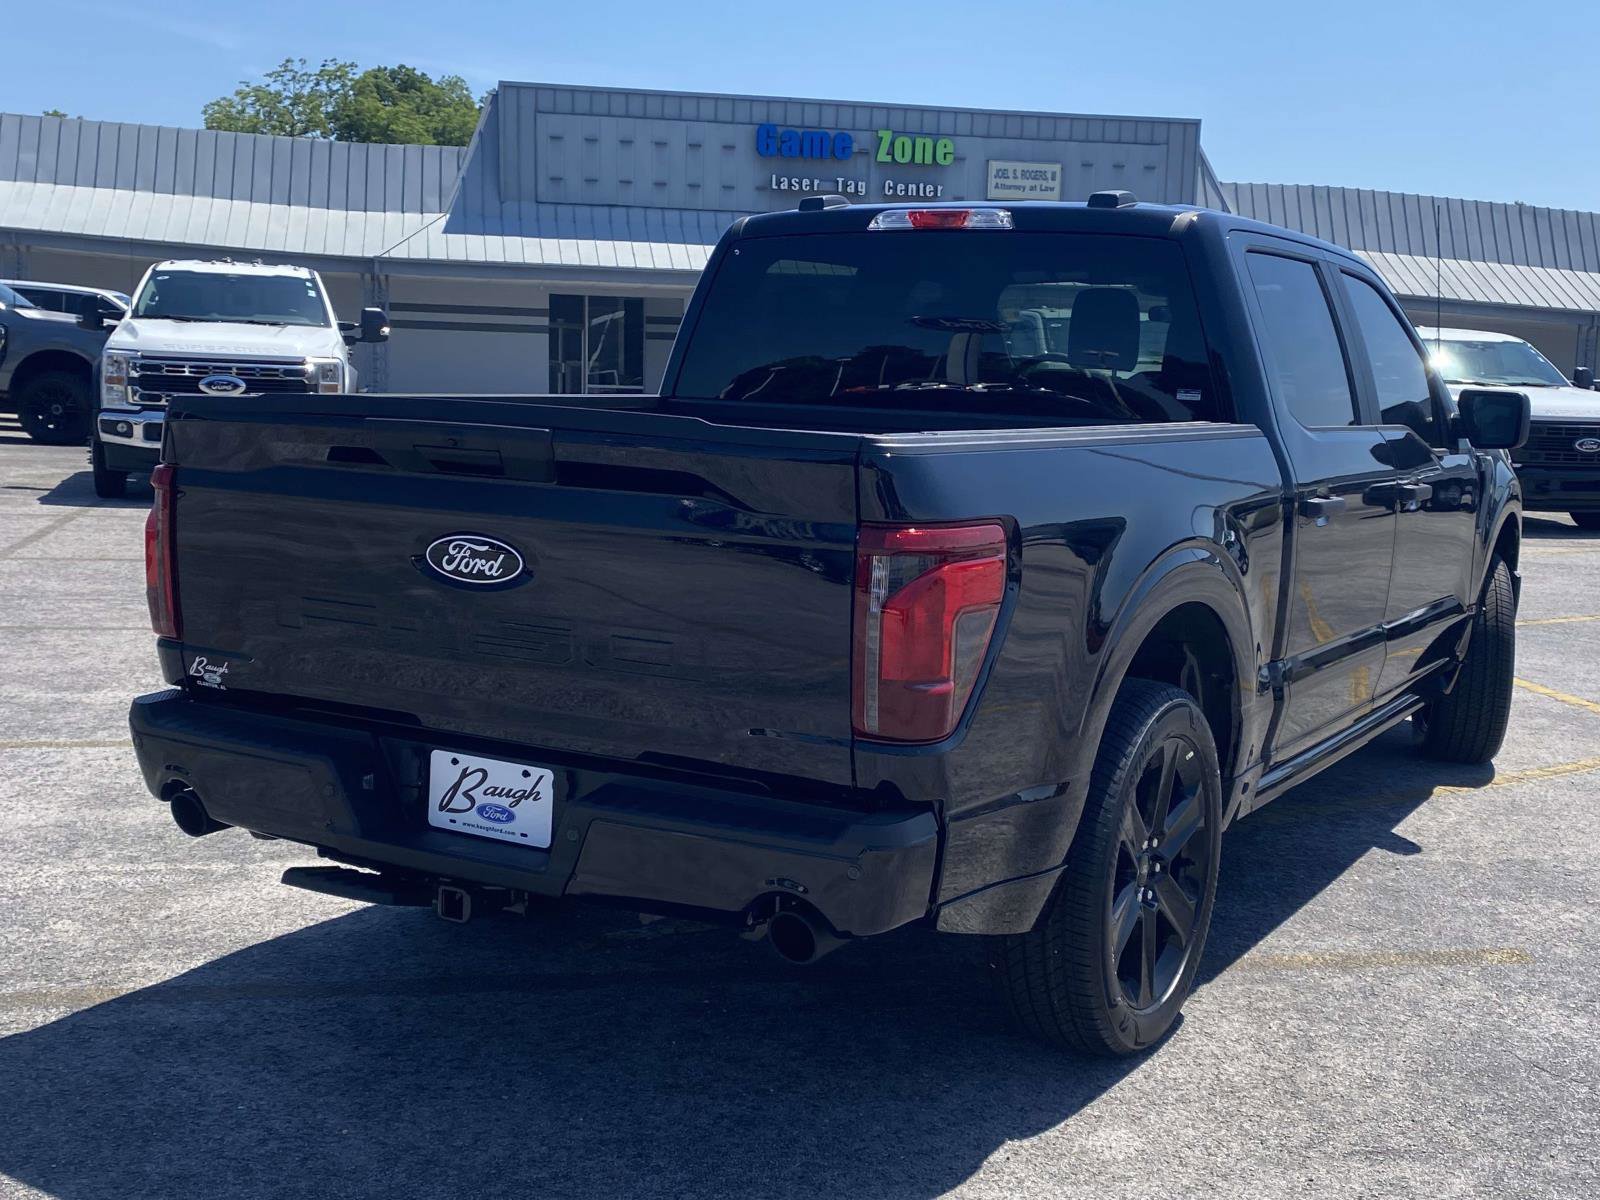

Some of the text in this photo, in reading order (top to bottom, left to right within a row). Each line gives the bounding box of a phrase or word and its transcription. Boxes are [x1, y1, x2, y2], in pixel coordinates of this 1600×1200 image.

[757, 122, 955, 166] Game Zone
[994, 168, 1010, 179] JOEL
[771, 174, 944, 197] Laser Tag Center
[994, 182, 1055, 192] Attorney at Law
[442, 541, 505, 577] Ford
[190, 656, 228, 676] Baugh
[438, 766, 544, 814] Baugh
[482, 806, 508, 820] Ford
[462, 821, 517, 836] www.baughford.com
